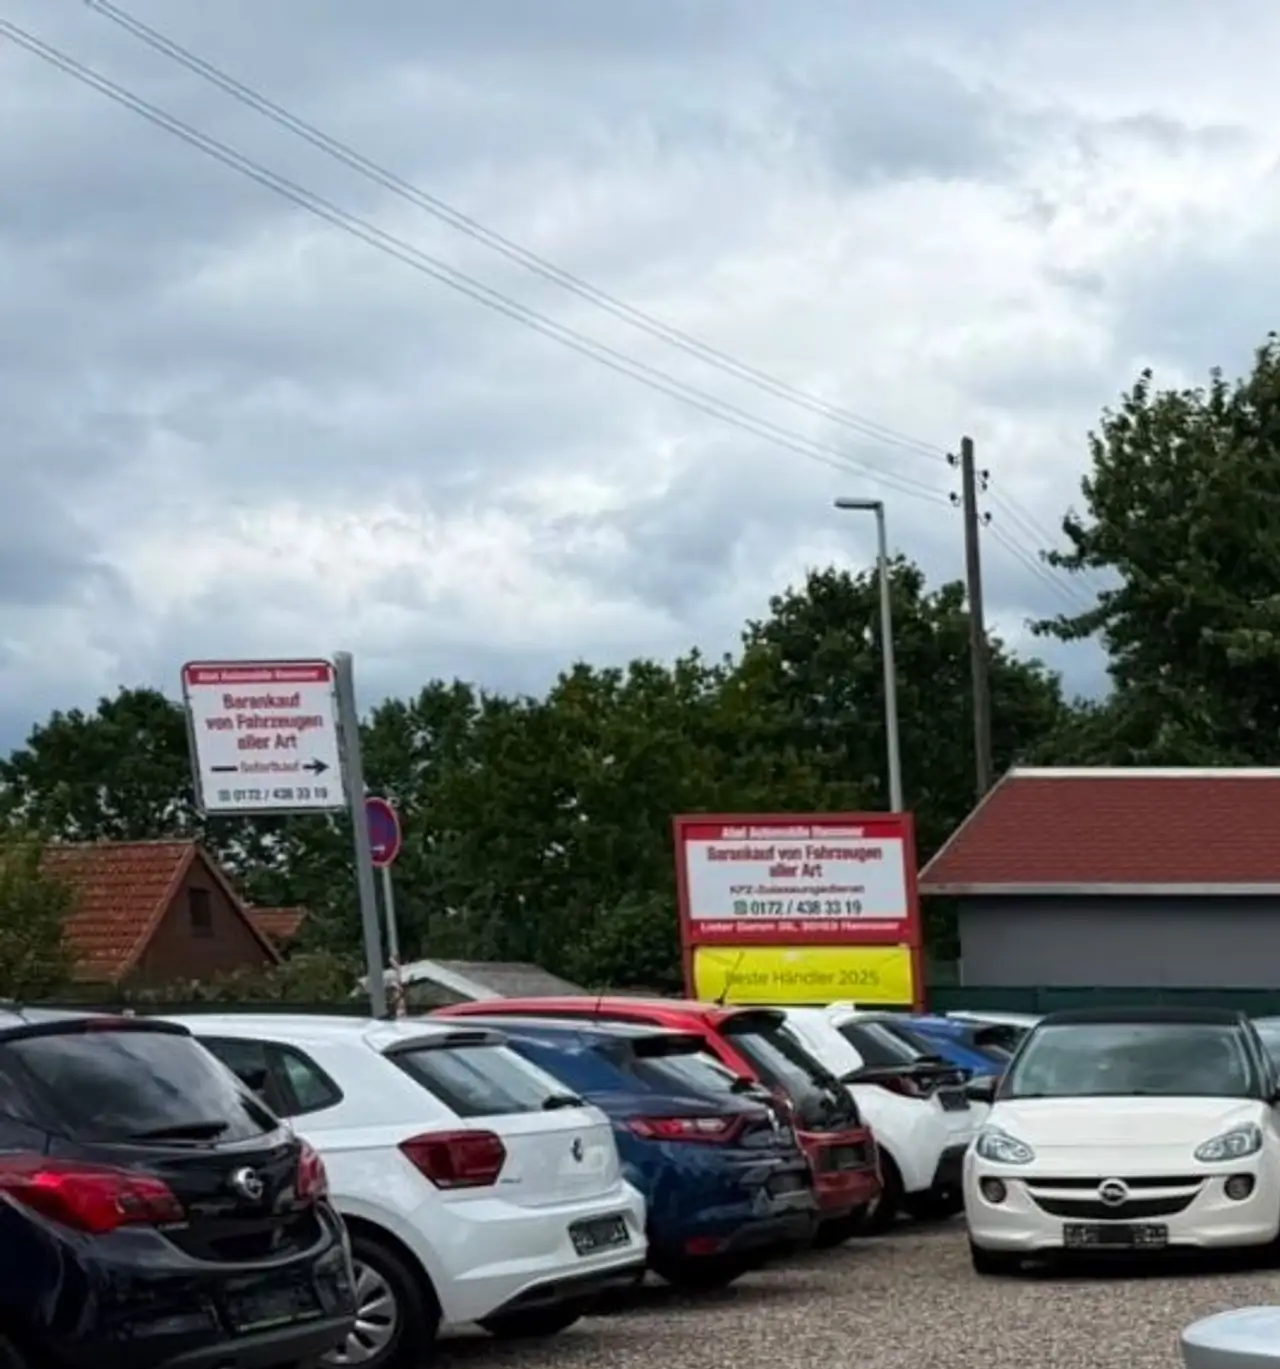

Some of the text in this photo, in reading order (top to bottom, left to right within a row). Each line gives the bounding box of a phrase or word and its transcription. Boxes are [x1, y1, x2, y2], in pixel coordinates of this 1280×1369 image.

[223, 692, 300, 709] Barankauf
[206, 713, 323, 732] von Fahrzeugen
[237, 734, 297, 749] aller Art
[297, 787, 310, 799] 33
[314, 786, 327, 798] 19
[707, 846, 882, 863] Barankauf von Fahrzeugen
[769, 863, 822, 877] aller Art
[751, 901, 783, 915] 0172
[797, 901, 822, 915] 438
[825, 901, 842, 915] 33
[845, 901, 861, 915] 19
[839, 969, 880, 985] 2025
